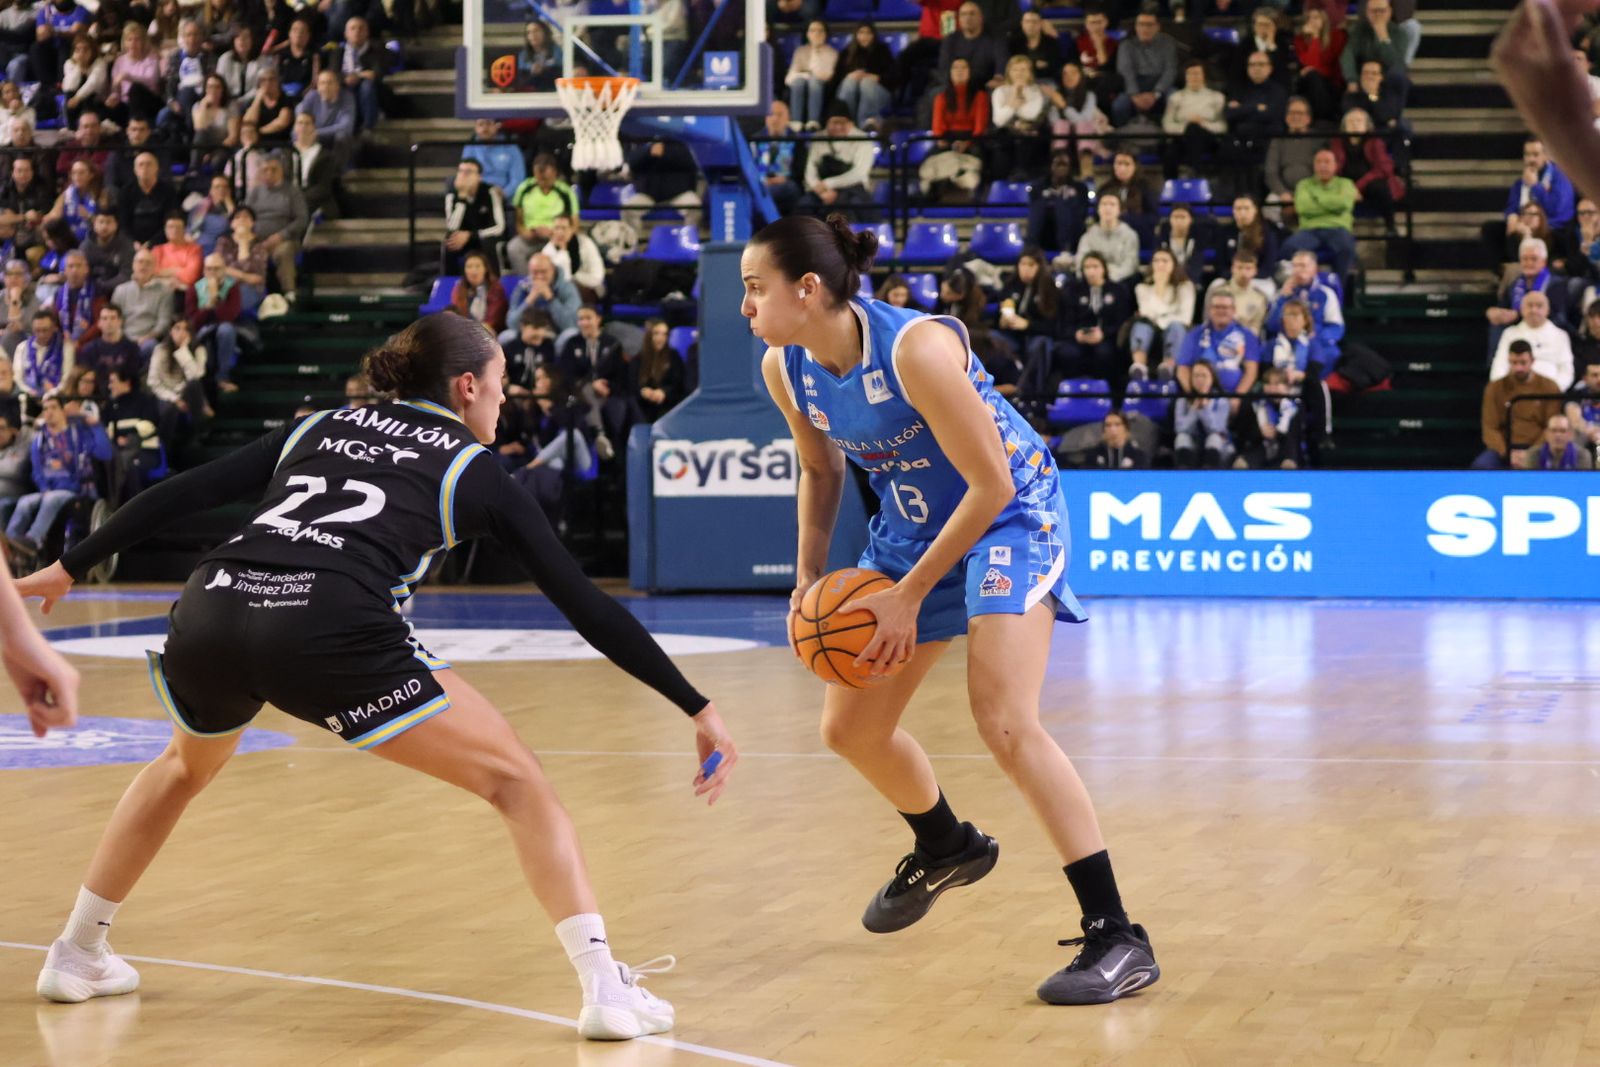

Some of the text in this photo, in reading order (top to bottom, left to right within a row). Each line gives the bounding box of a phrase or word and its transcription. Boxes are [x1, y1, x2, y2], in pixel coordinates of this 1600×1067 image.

[887, 420, 924, 447] LEÓN
[252, 474, 386, 525] 22
[890, 479, 929, 523] 13
[1089, 491, 1312, 540] MAS
[1089, 543, 1312, 572] PREVENCIÓN
[281, 582, 312, 595] Díaz
[348, 678, 421, 723] MADRID
